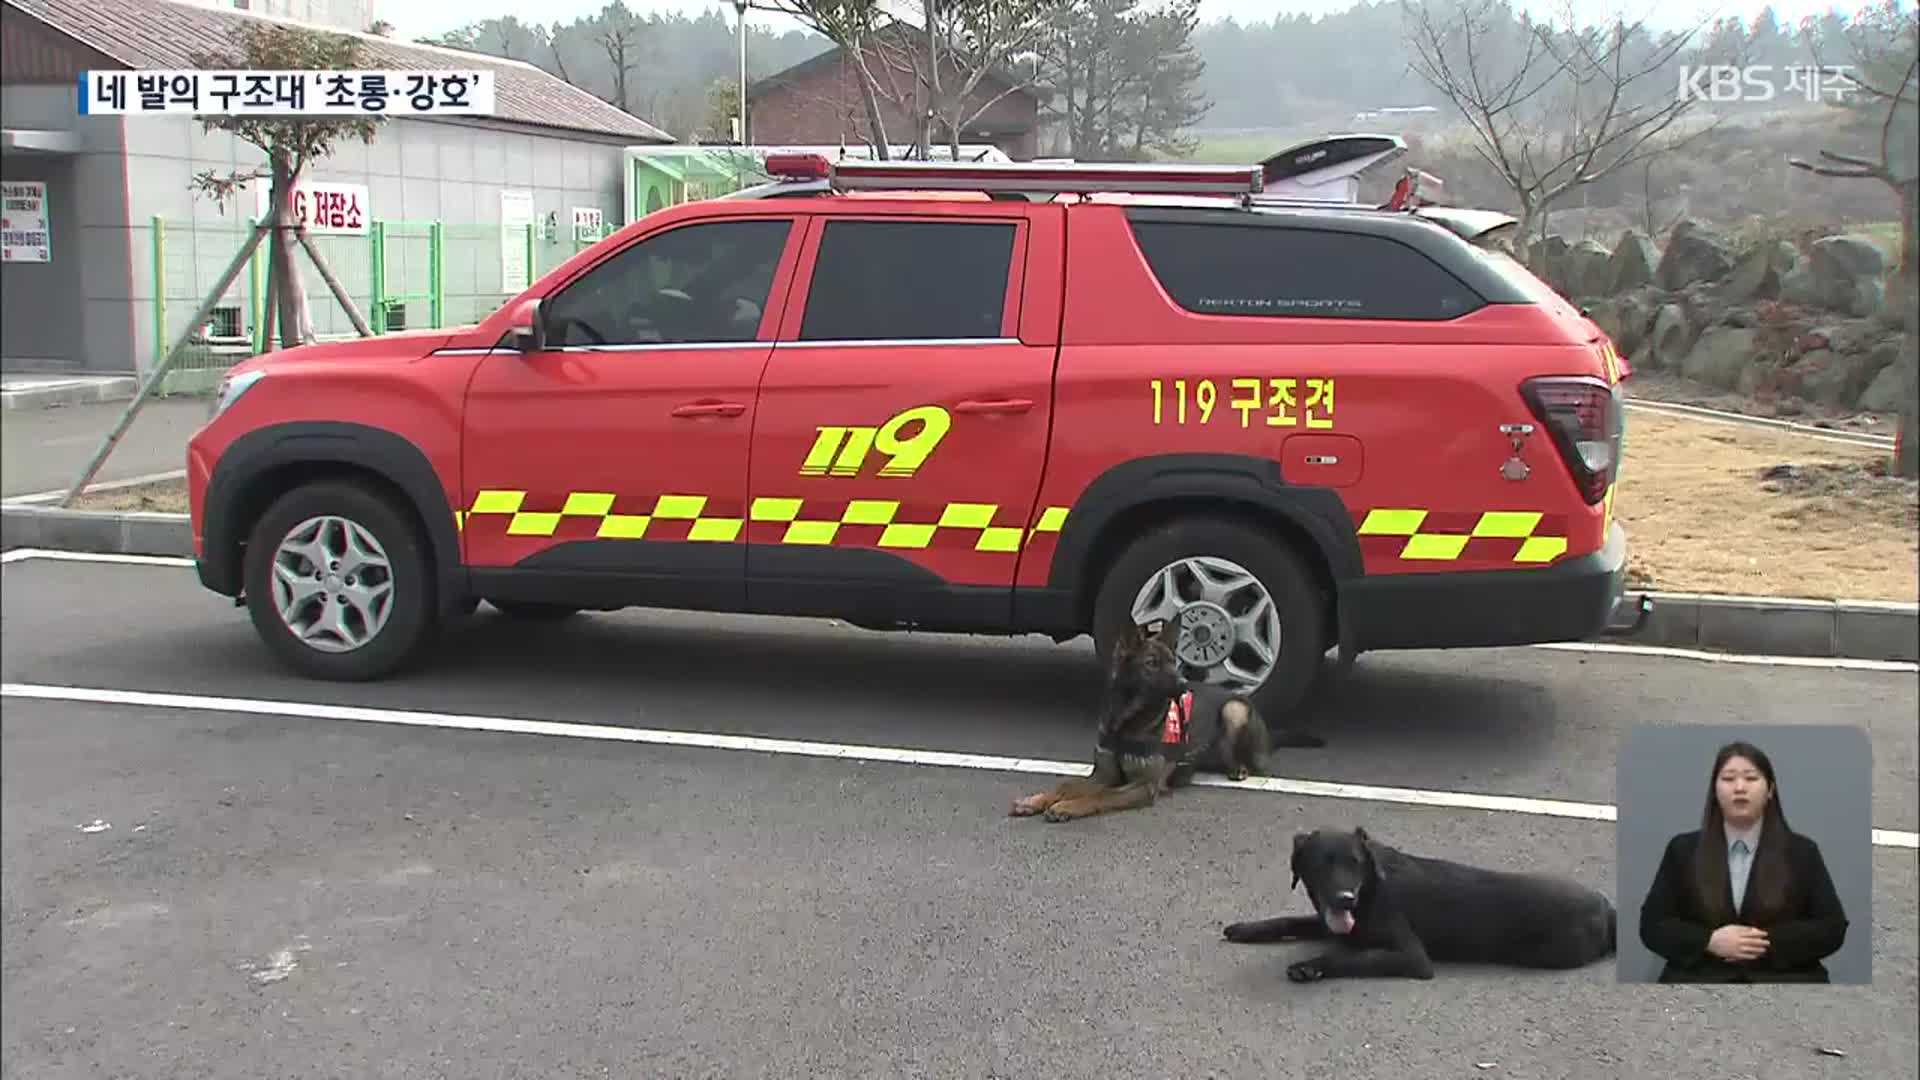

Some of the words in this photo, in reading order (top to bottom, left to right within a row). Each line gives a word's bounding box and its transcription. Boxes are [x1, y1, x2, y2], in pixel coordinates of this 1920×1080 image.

[312, 191, 362, 228] 저장소
[1151, 379, 1217, 424] 119
[1231, 378, 1334, 429] 구조견
[799, 405, 951, 478] 119
